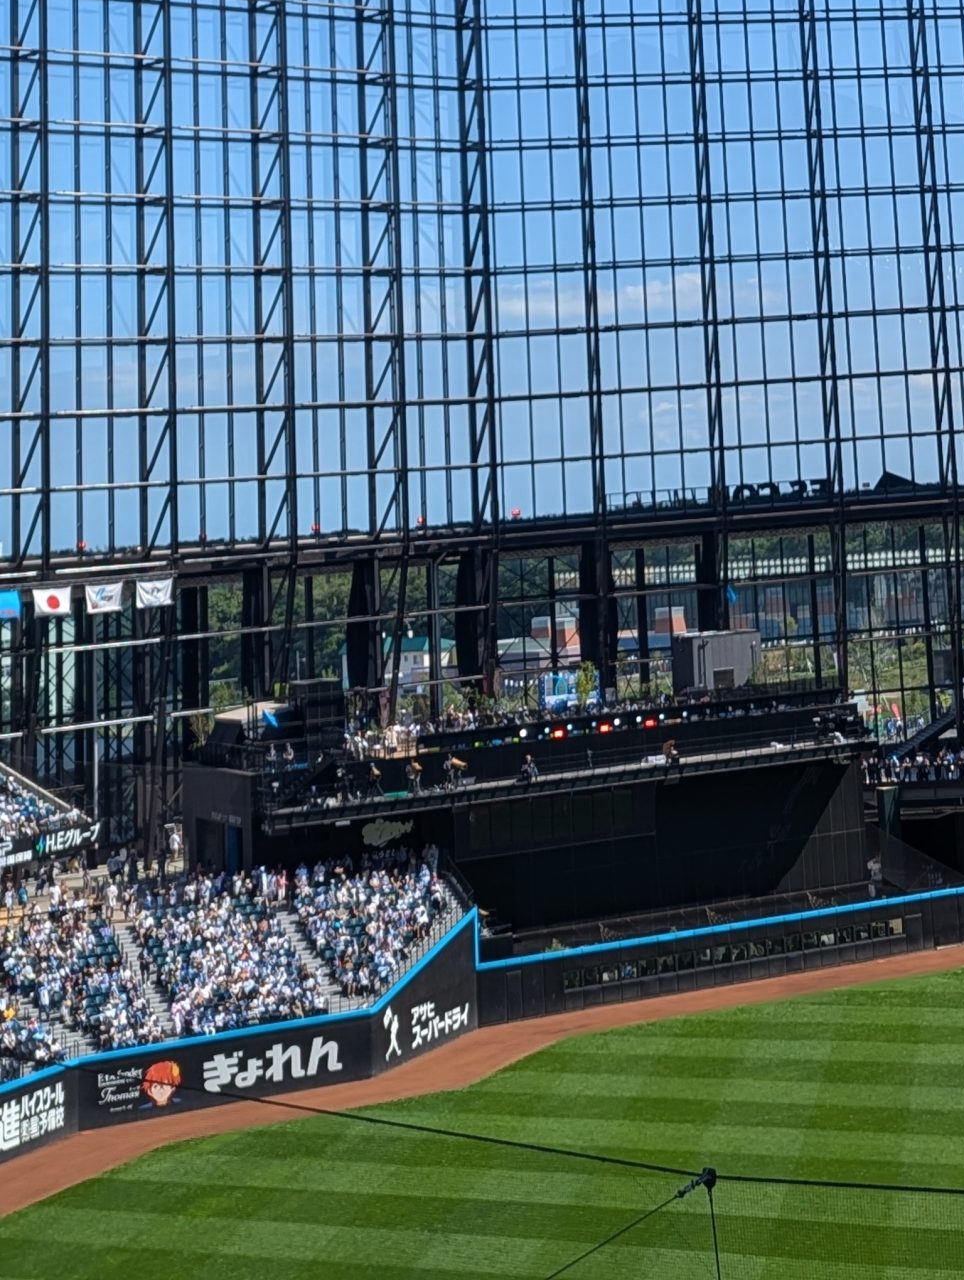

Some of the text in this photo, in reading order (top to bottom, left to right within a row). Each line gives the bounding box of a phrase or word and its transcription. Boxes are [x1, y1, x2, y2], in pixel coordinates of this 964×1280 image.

[45, 822, 100, 854] H.Eグループ
[411, 1001, 435, 1026] アサヒ
[412, 1002, 469, 1049] スーパードライ
[203, 1036, 343, 1093] ぎょれん
[21, 1081, 65, 1119] ハイスクール
